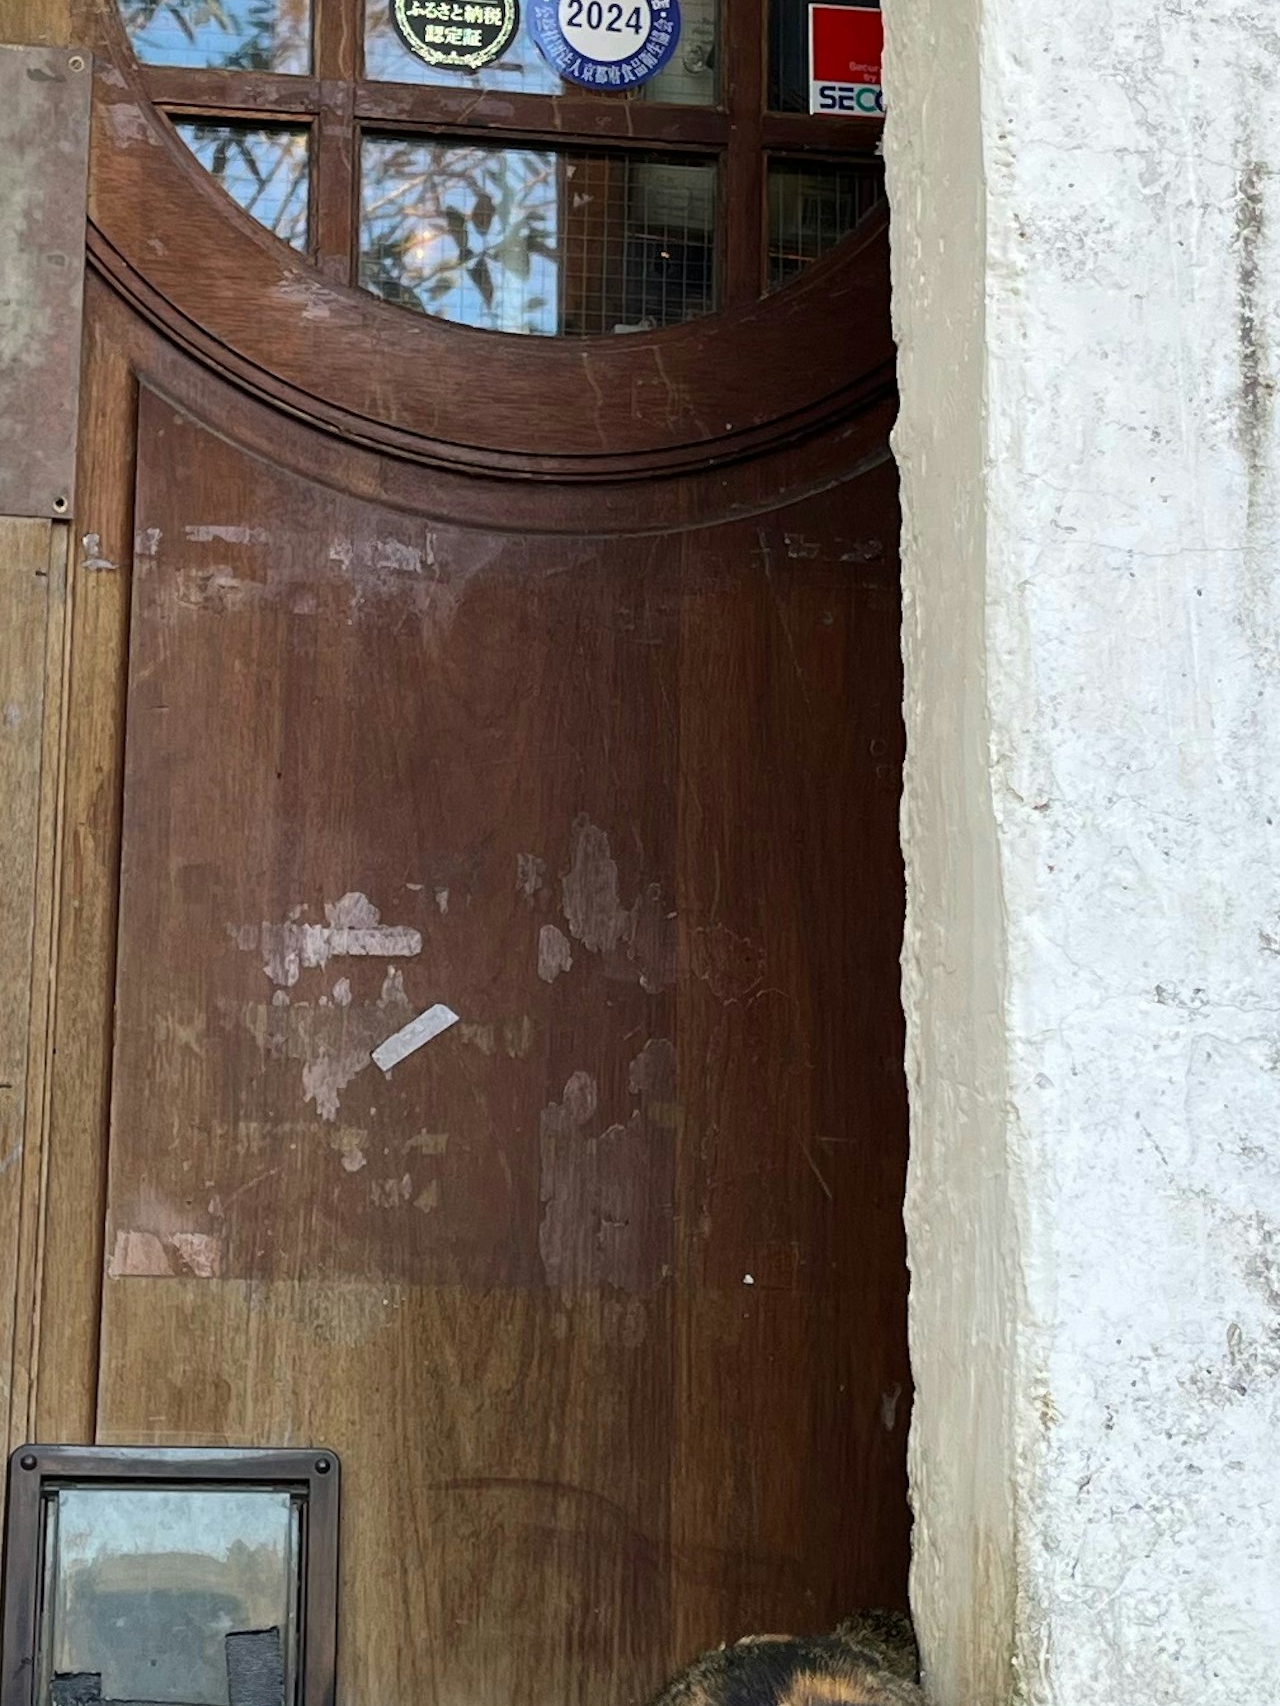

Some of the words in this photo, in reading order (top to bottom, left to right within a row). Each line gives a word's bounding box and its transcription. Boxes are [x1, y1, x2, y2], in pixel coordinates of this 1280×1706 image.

[406, 0, 503, 26] ふるさと納税
[424, 24, 483, 47] 認定証
